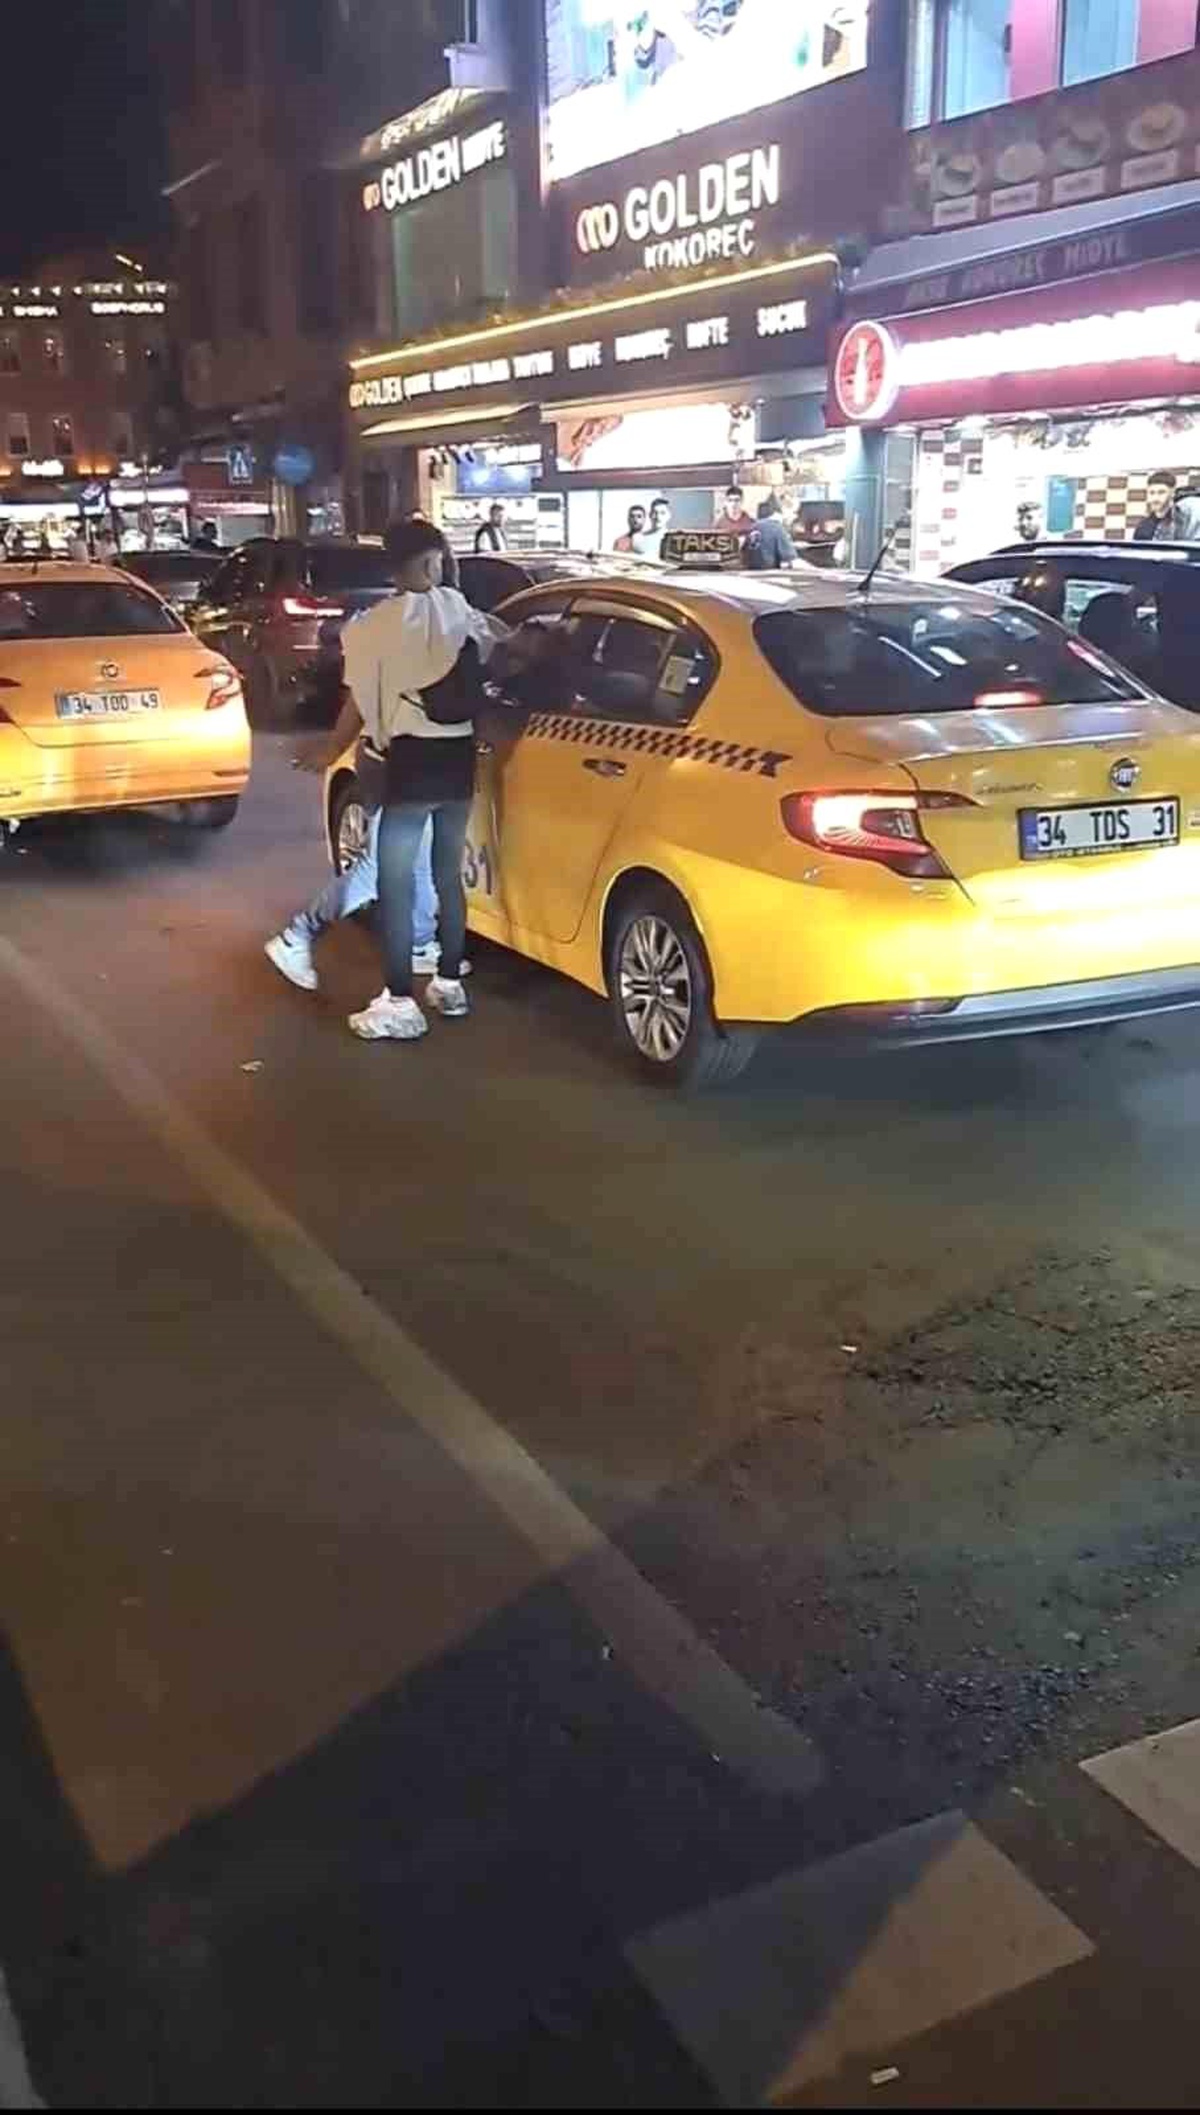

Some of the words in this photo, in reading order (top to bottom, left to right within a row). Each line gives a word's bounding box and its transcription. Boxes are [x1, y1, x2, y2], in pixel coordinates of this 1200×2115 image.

[381, 137, 460, 209] GOLDEN
[625, 144, 780, 240] GOLDEN
[73, 697, 92, 714] 34
[141, 693, 158, 708] 49
[1038, 814, 1067, 848] 34
[1089, 808, 1131, 842] TDS
[1152, 805, 1176, 836] 31
